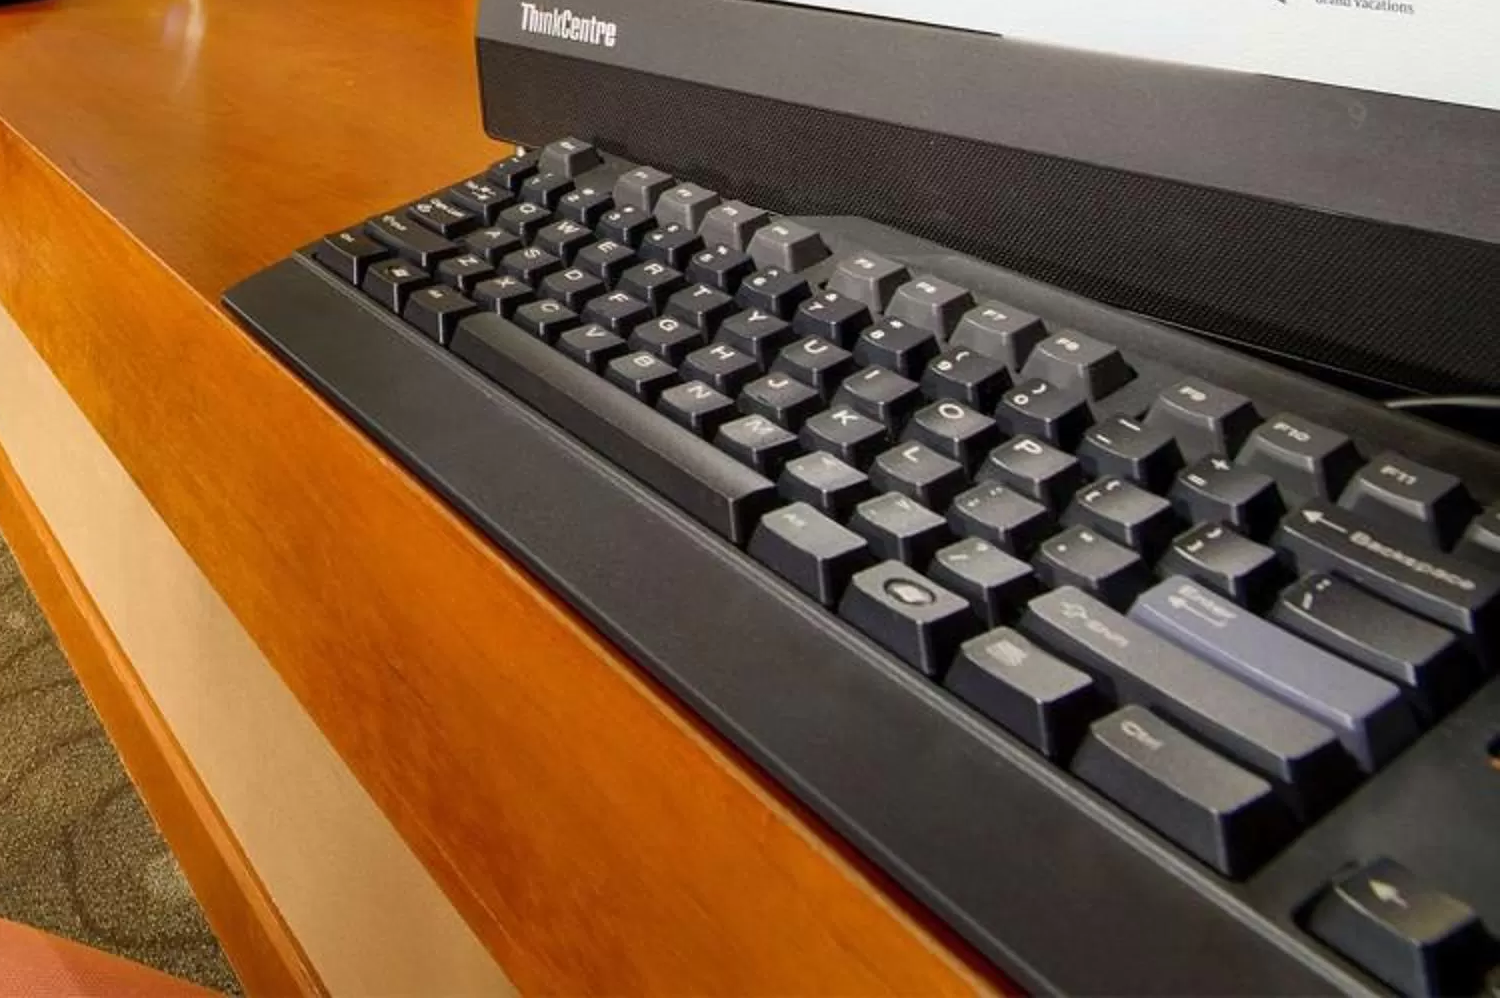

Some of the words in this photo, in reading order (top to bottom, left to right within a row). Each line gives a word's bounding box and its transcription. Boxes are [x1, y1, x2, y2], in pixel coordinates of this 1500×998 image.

[521, 1, 617, 47] ThinkCentre
[597, 241, 619, 254] E
[564, 269, 584, 281] D
[644, 263, 664, 276] R
[608, 292, 629, 303] F
[693, 285, 712, 297] T
[748, 310, 769, 322] Y
[585, 326, 605, 338] V
[659, 318, 679, 332] G
[710, 345, 736, 360] H
[804, 339, 828, 353] U
[633, 355, 655, 367] B
[768, 378, 789, 389] J
[687, 383, 712, 399] N
[832, 409, 859, 426] K
[938, 403, 965, 419] O
[1272, 421, 1311, 443] F10
[902, 446, 920, 462] L
[1013, 439, 1043, 455] P
